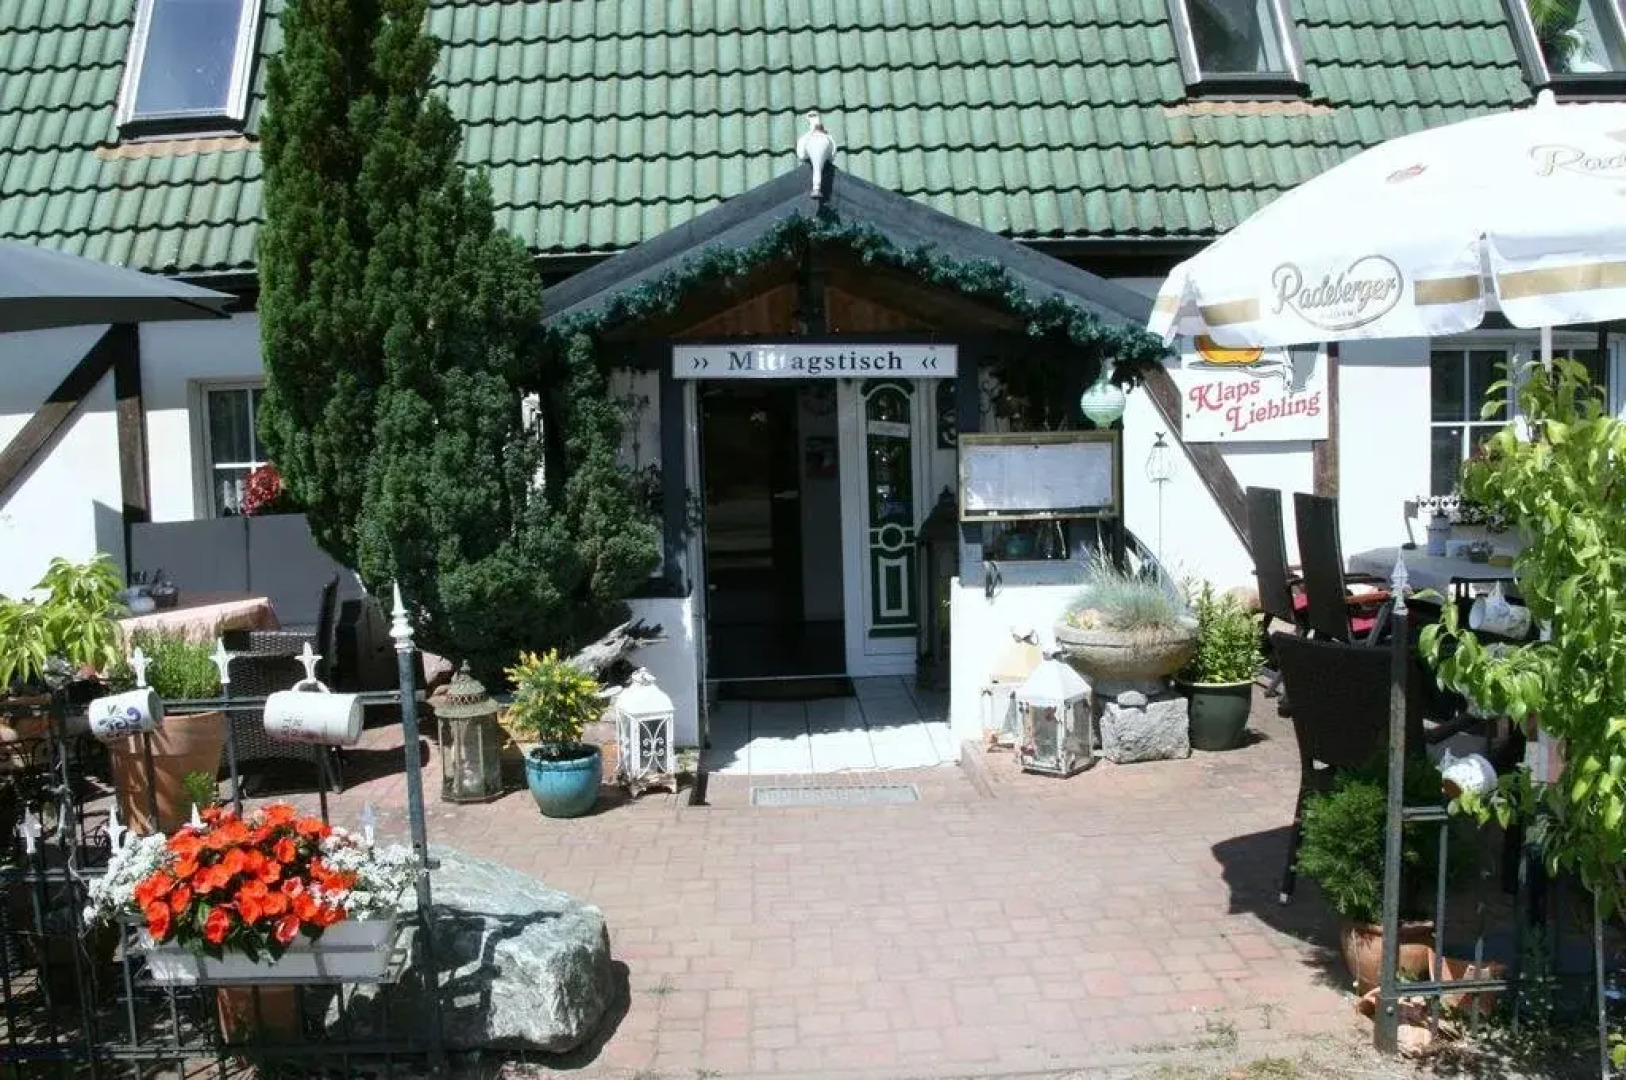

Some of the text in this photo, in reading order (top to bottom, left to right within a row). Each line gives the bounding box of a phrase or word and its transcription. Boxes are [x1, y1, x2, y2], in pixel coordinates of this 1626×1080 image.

[1271, 258, 1400, 317] Radeberger
[728, 350, 903, 375] Mittagstisch
[1189, 379, 1260, 412] Klaps
[1226, 391, 1322, 432] Liebling
